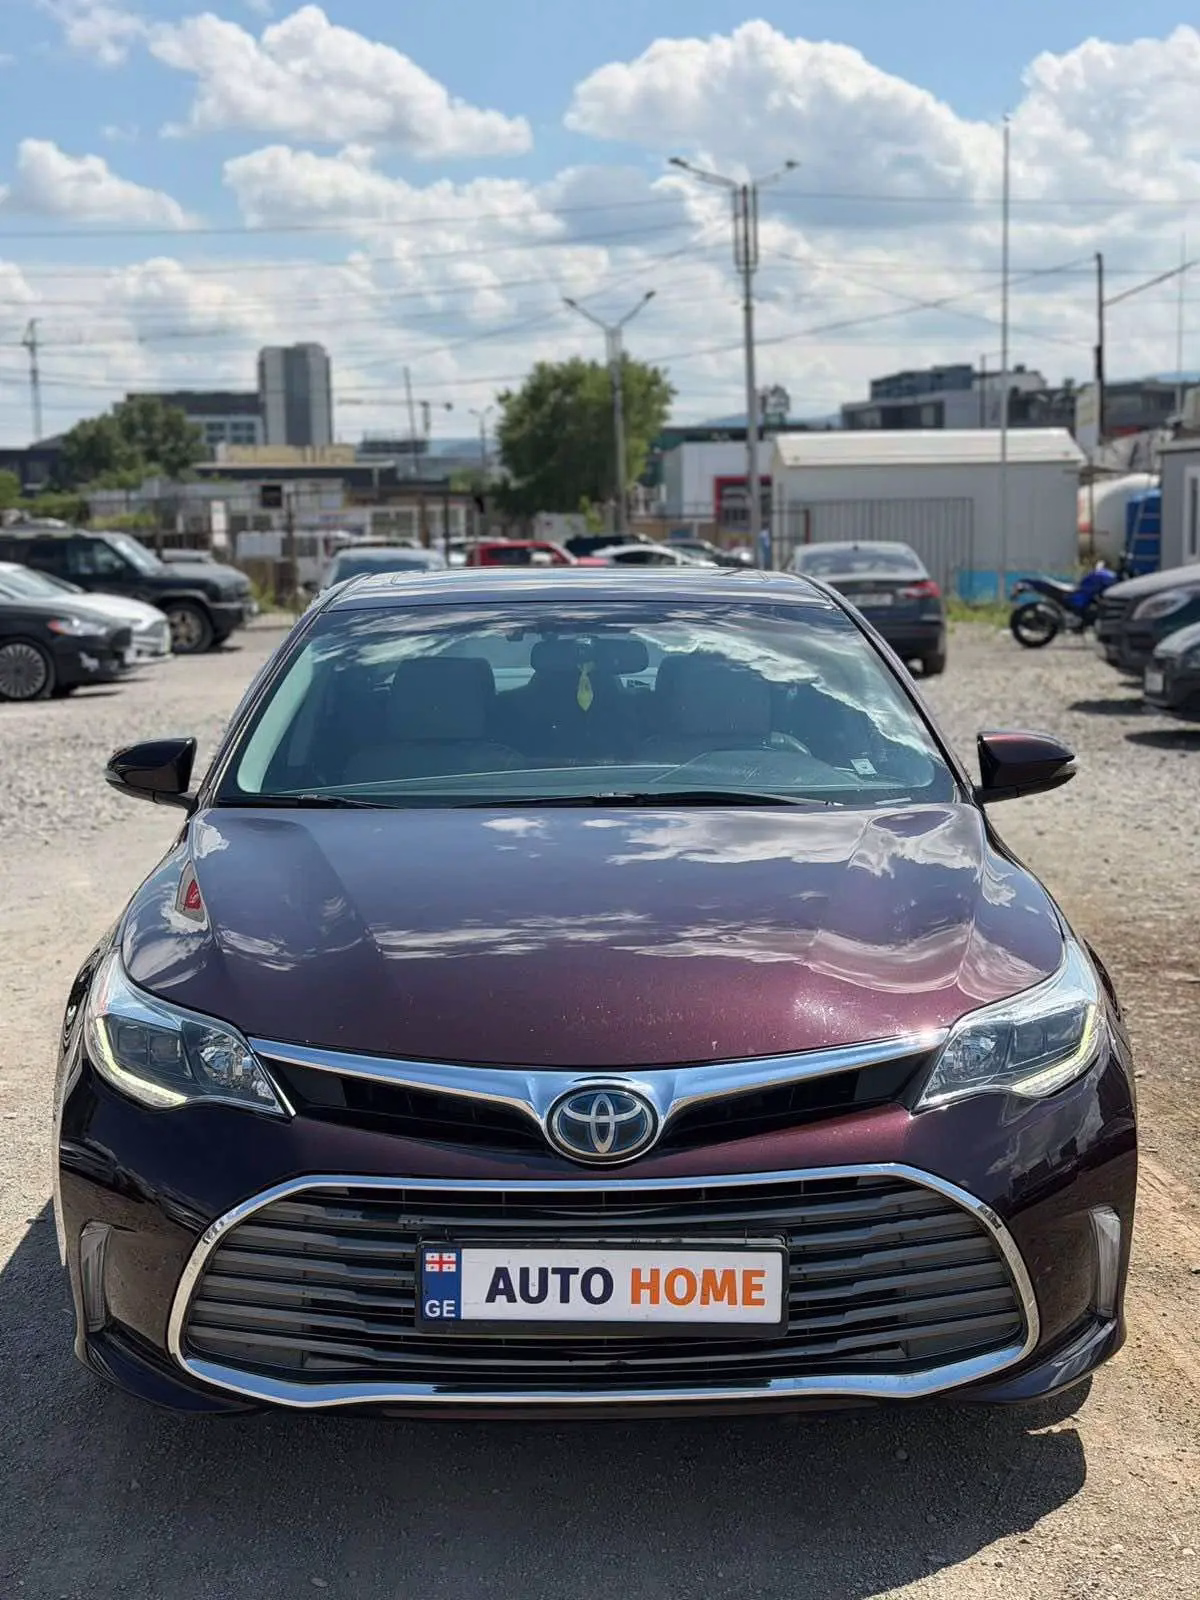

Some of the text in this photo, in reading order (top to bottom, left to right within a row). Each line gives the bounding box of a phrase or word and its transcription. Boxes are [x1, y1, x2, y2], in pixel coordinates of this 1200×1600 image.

[485, 1266, 766, 1306] AUTO HOME
[424, 1299, 456, 1318] GE
